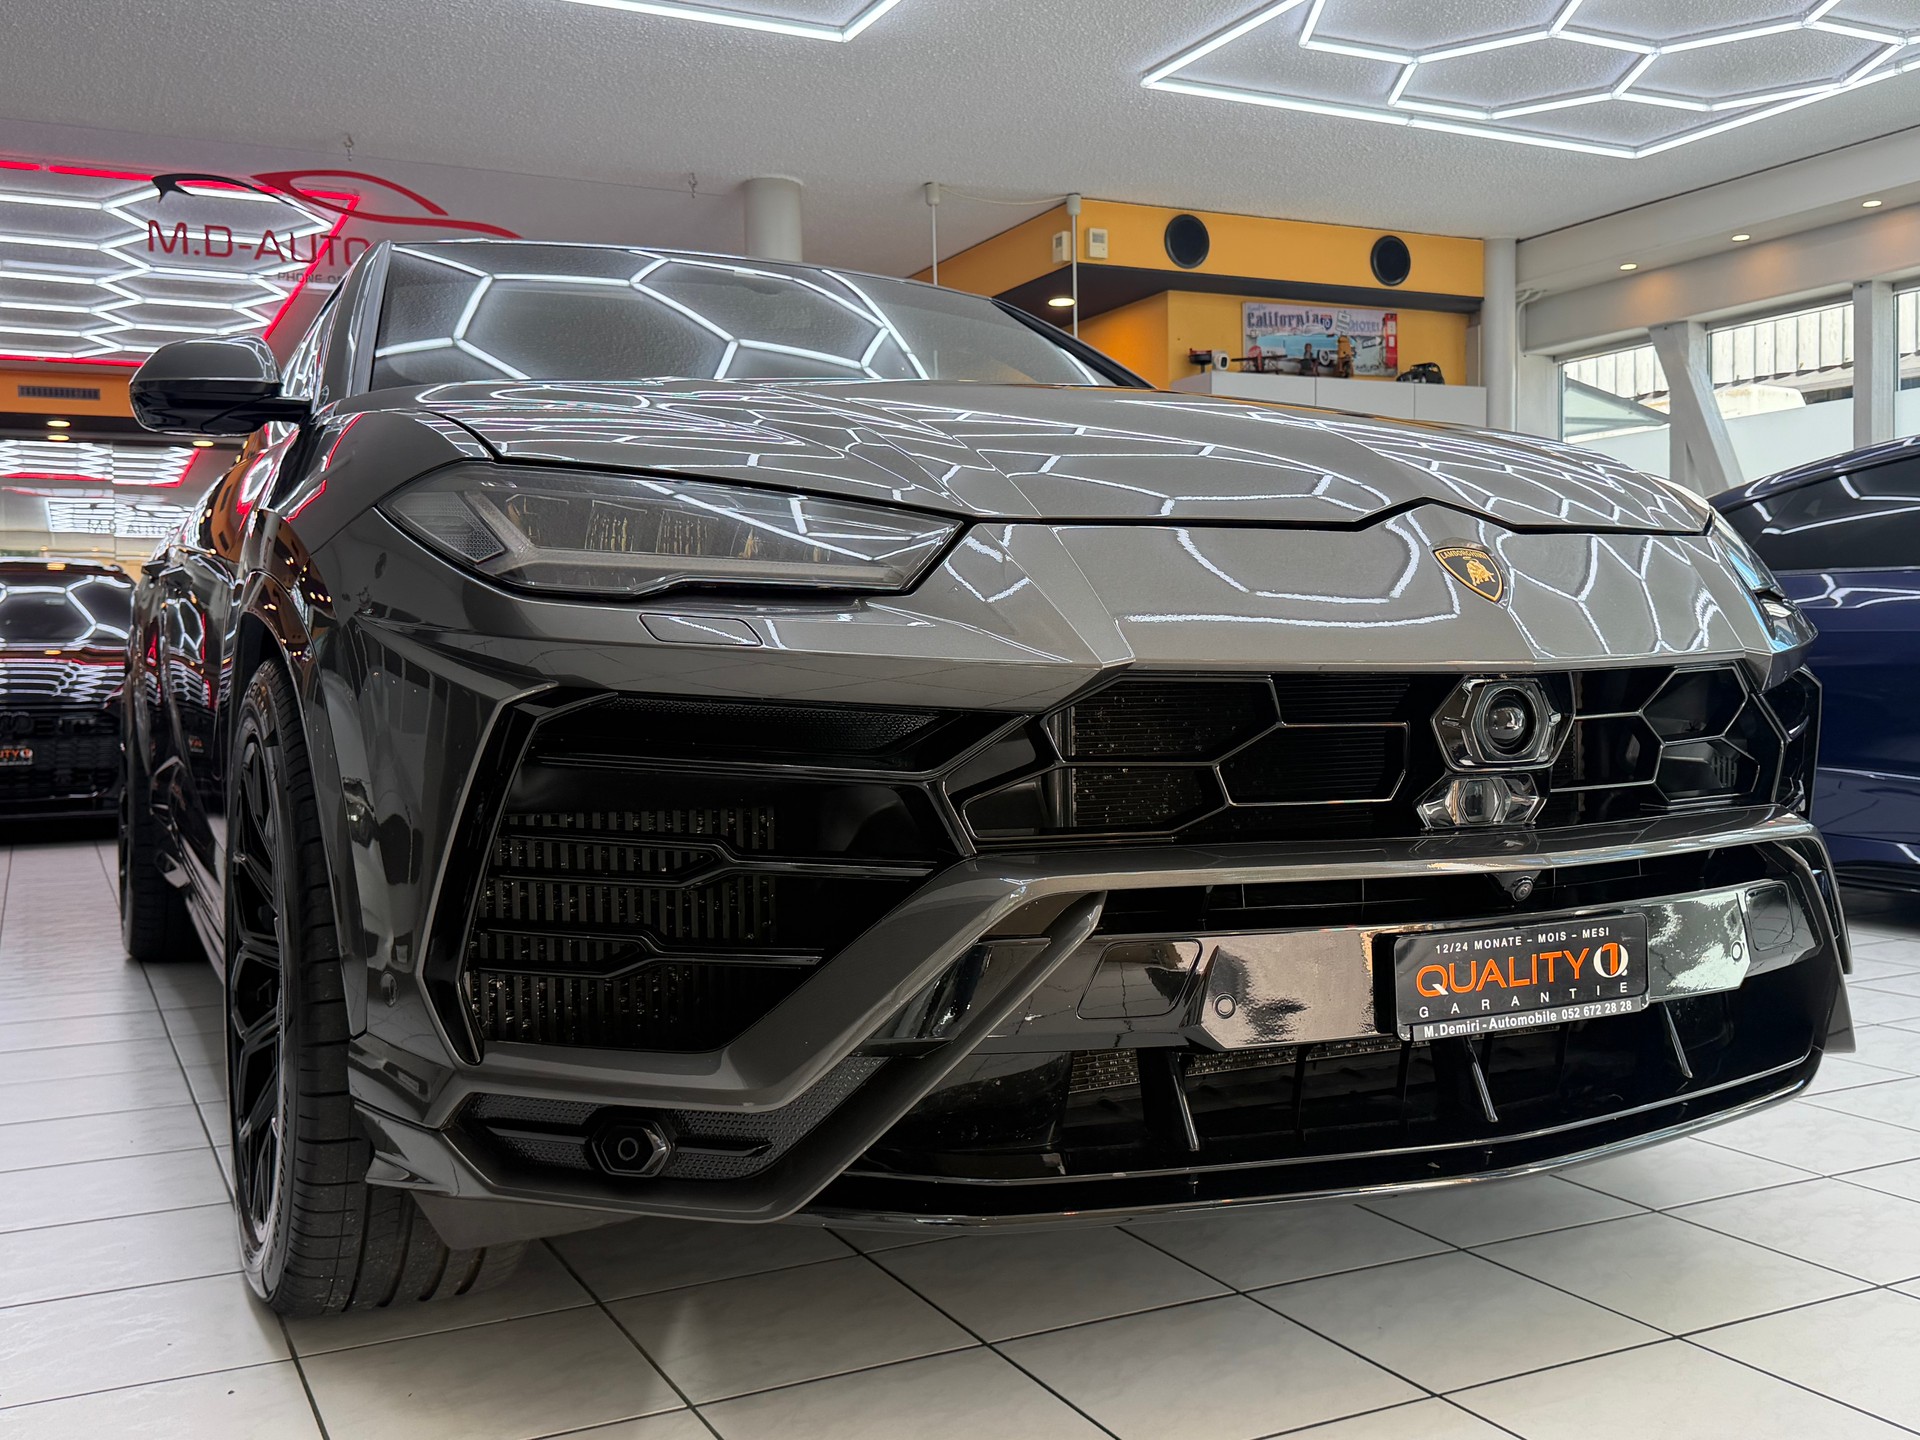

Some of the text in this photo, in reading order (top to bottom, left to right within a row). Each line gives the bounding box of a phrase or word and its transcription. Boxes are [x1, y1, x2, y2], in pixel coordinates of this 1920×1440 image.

[277, 272, 322, 284] PHONE
[1247, 311, 1319, 328] California
[1435, 941, 1468, 954] 12/24
[1474, 936, 1522, 950] MONATE
[1538, 931, 1567, 943] MOIS
[1582, 927, 1609, 939] MESI
[1416, 947, 1590, 997] QUALITY
[1419, 982, 1628, 1018] GARANTIE
[1489, 1010, 1557, 1030] Automobile
[1562, 1008, 1580, 1019] 052
[1584, 1004, 1601, 1016] 672
[1605, 1002, 1617, 1014] 28
[1620, 1000, 1632, 1012] 28
